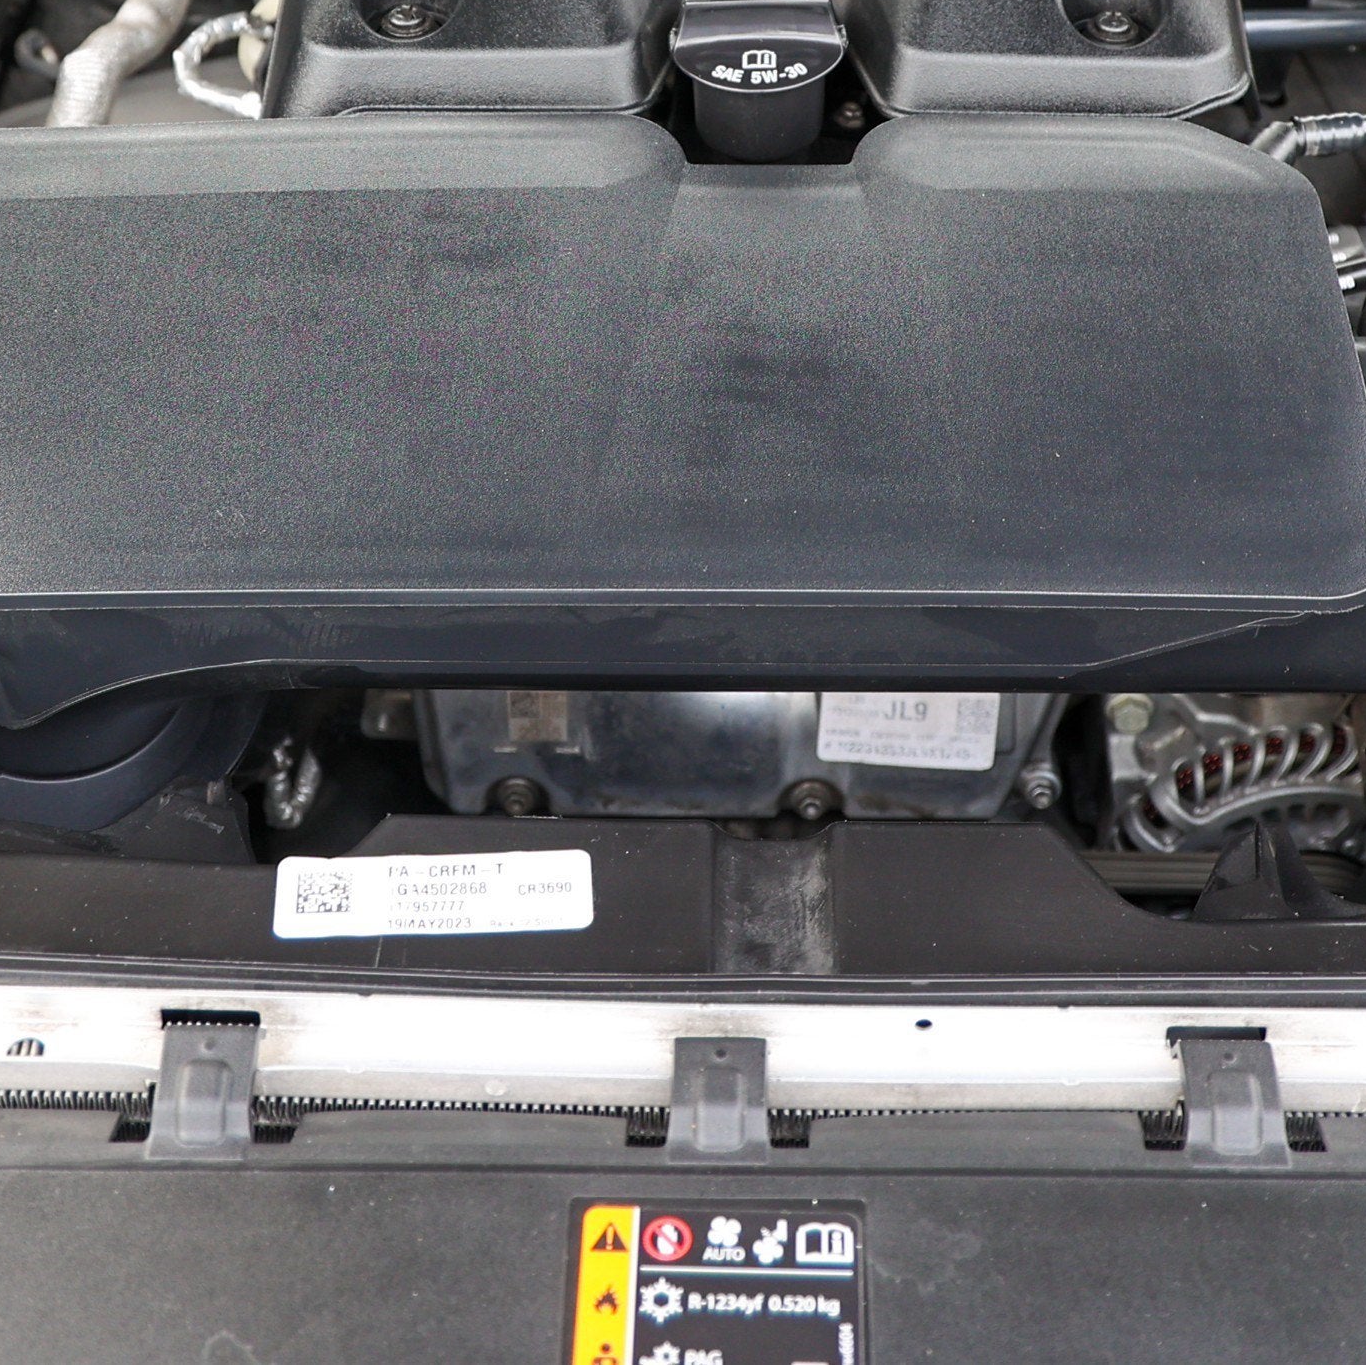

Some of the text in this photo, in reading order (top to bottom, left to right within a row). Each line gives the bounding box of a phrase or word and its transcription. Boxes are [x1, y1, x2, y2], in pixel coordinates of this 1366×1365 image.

[711, 63, 808, 85] SAE 5W-30
[884, 700, 929, 722] JL9
[518, 881, 572, 896] CR3690
[702, 1247, 746, 1262] AUTO
[688, 1292, 841, 1317] R-1234yf 0.520 kg
